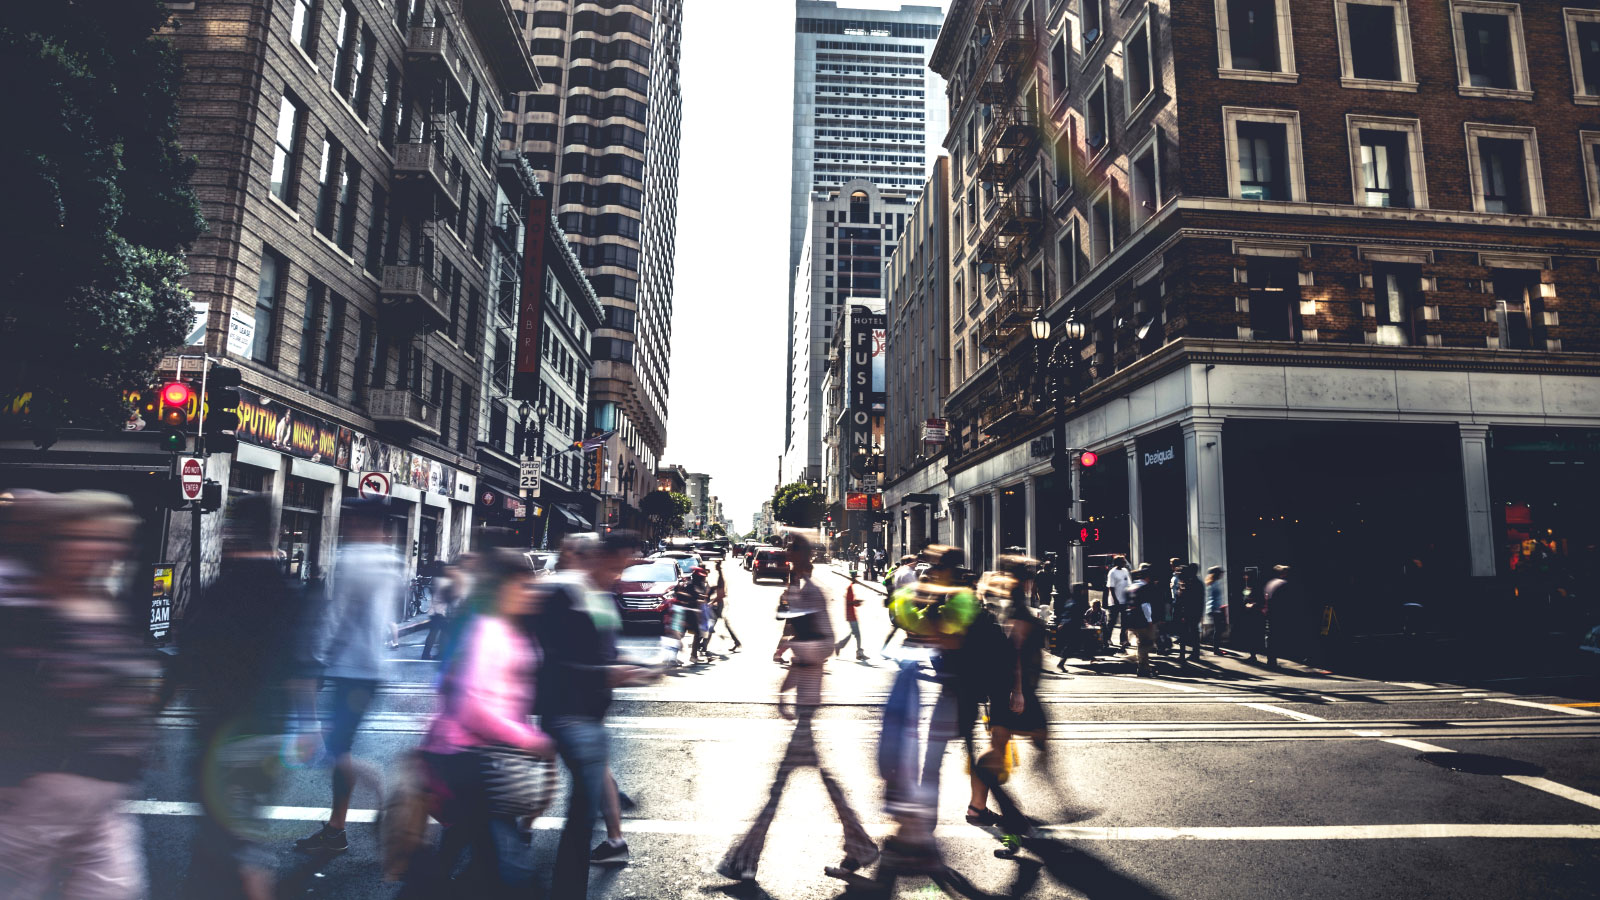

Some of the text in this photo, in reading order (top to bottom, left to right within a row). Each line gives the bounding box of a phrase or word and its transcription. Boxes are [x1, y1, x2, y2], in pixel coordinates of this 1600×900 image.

[854, 317, 884, 325] HOTEL
[524, 303, 534, 365] ABRI
[855, 332, 868, 445] FUSION
[292, 420, 315, 452] MUSIC
[184, 466, 200, 474] DO NOT
[185, 483, 199, 492] ENTER
[521, 476, 538, 487] 25
[1094, 528, 1099, 541] 3
[150, 606, 170, 623] 3AM
